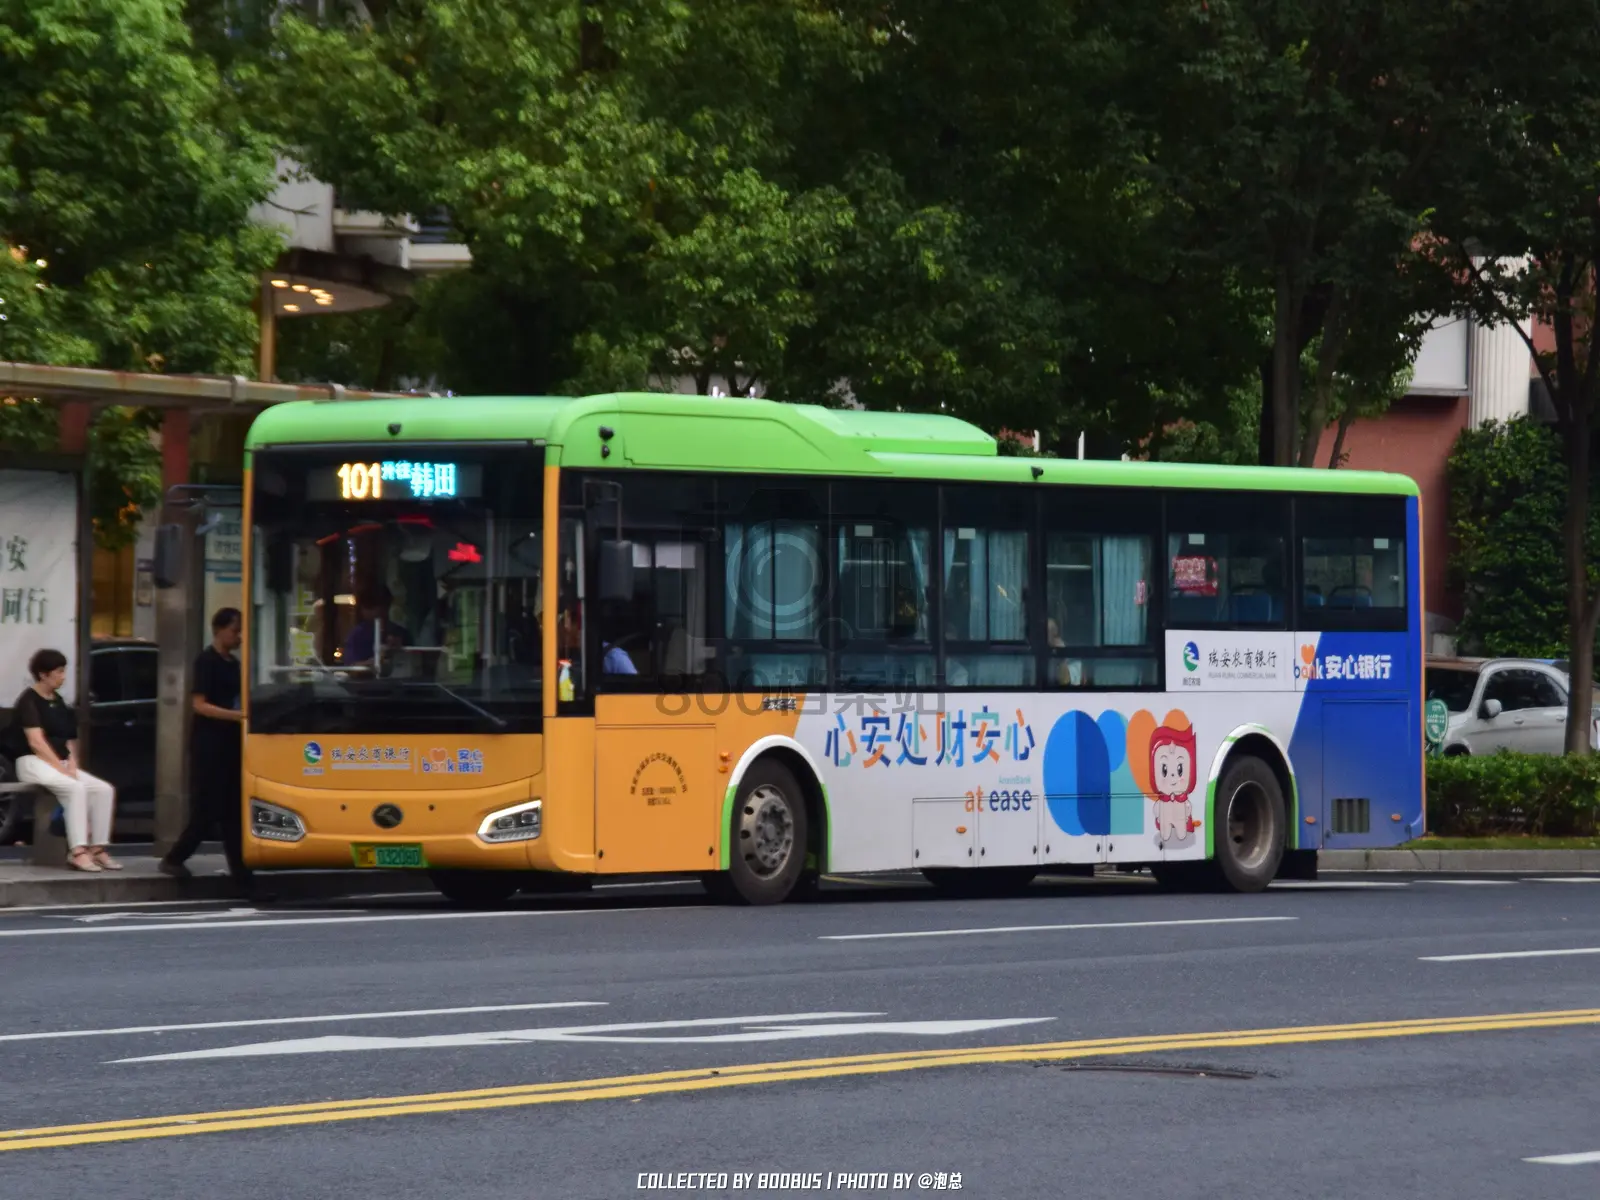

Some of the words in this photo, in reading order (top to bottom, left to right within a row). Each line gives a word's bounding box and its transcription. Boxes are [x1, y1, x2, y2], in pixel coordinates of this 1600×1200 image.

[338, 463, 381, 498] 101
[410, 462, 456, 497] 韩田
[1208, 648, 1277, 669] 瑞安农商银行
[1325, 655, 1392, 679] 安心银行
[825, 705, 1035, 768] 心安处财安心
[964, 786, 984, 812] at
[989, 789, 1032, 811] ease
